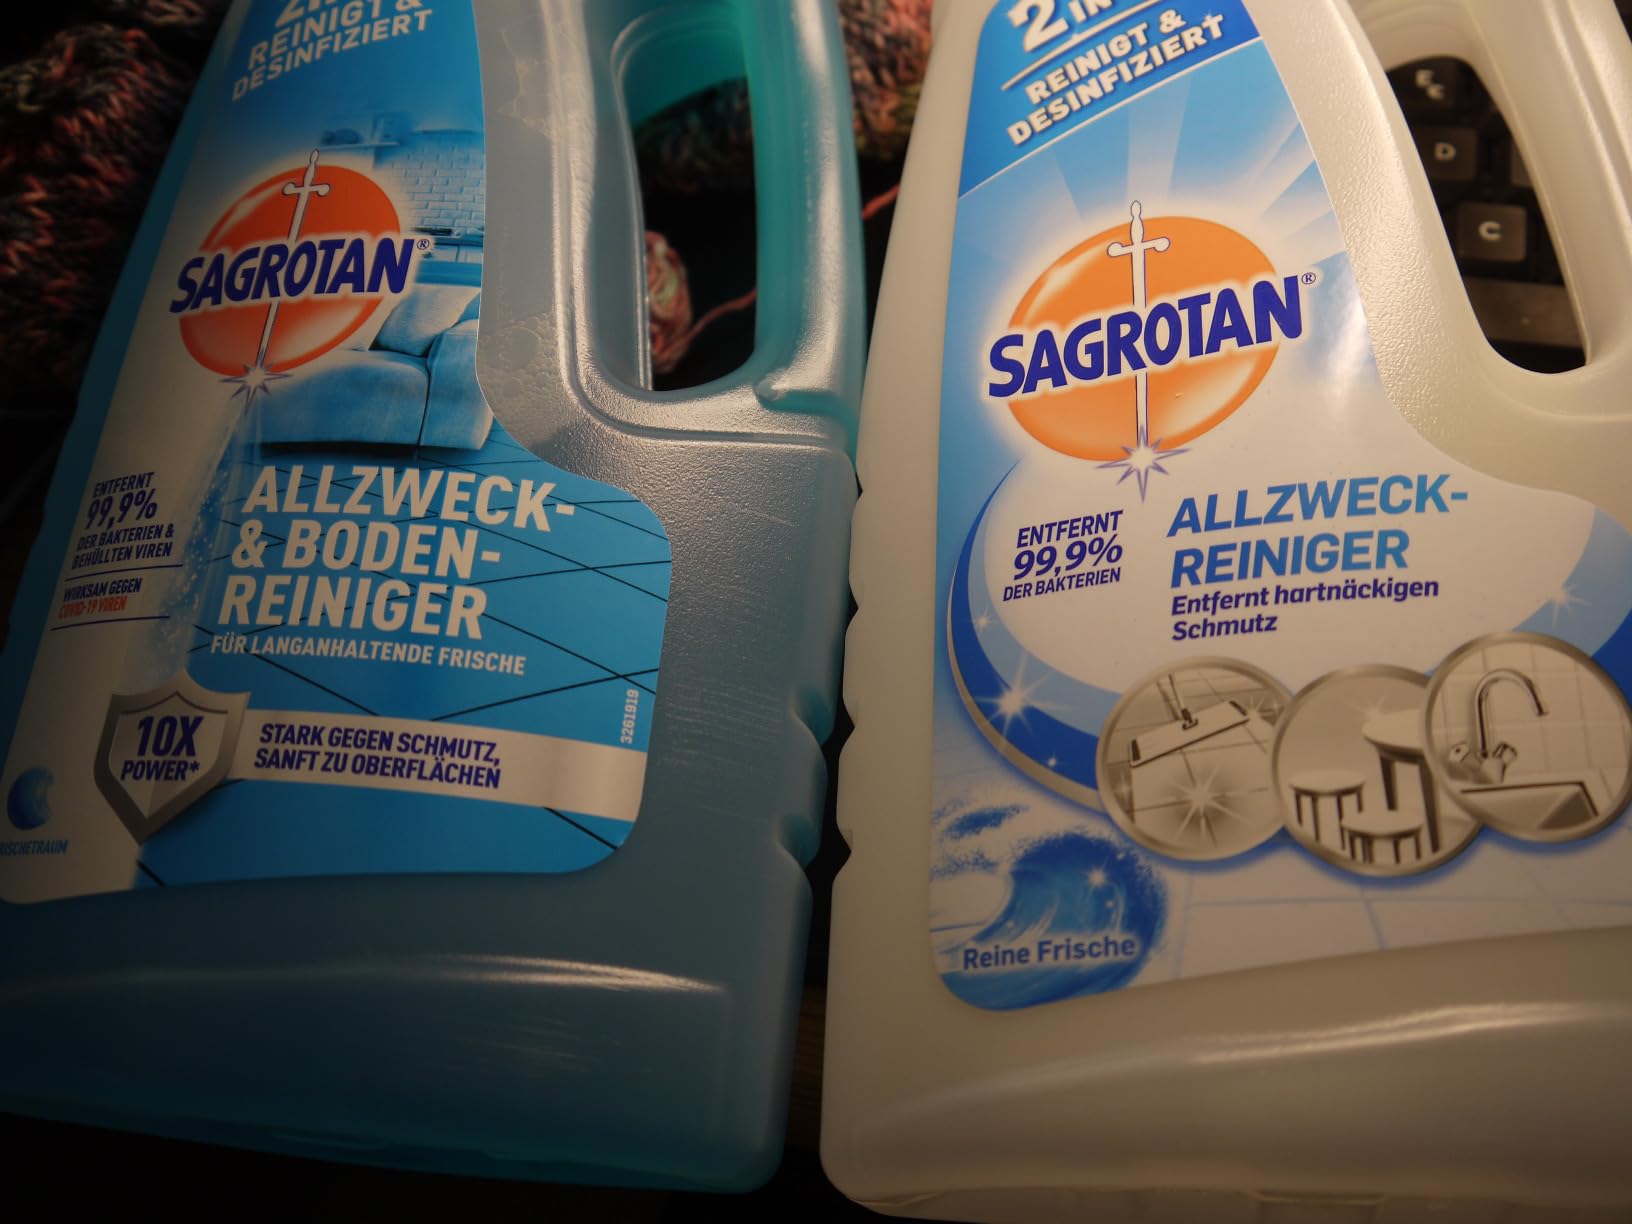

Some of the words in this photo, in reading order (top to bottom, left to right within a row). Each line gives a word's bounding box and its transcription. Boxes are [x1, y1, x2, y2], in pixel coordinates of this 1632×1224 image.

[248, 0, 384, 68] REINIGT
[231, 9, 433, 102] DESINFIZIERT
[1025, 21, 1148, 104] REINIGT
[1158, 9, 1187, 34] &
[1007, 14, 1224, 146] DESINFIZIERT
[1434, 142, 1456, 161] D
[1478, 221, 1502, 241] C
[93, 472, 154, 498] ENTFERNT
[241, 464, 576, 532] ALLZWECK-
[85, 488, 157, 530] 99,9%
[1167, 474, 1469, 538] ALLZWECK-
[77, 533, 98, 550] DER
[99, 524, 163, 546] BAKTERIEN
[165, 523, 174, 538] &
[231, 519, 268, 568] &
[281, 518, 501, 579] BODEN-
[1017, 510, 1124, 548] ENTFERNT
[71, 545, 133, 570] BEHÜLLTEN
[135, 541, 173, 559] VIREN
[1013, 533, 1123, 580] 99,9%
[1170, 529, 1410, 588] REINIGER
[63, 583, 107, 602] WIRKSAM
[108, 578, 142, 595] GEGEN
[98, 596, 128, 612] VIREN
[1003, 582, 1034, 602] DER
[1035, 567, 1122, 595] BAKTERIEN
[1171, 585, 1270, 615] Entfernt
[1274, 576, 1439, 602] hartnäckigen
[218, 574, 488, 640] REINIGER
[1172, 613, 1279, 641] Schmutz
[210, 631, 247, 655] FÜR
[251, 635, 433, 666] LANGANHALTENDE
[438, 646, 527, 676] FRISCHE
[138, 716, 204, 757] 10X
[260, 723, 325, 746] STARK
[328, 726, 393, 752] GEGEN
[397, 733, 500, 766] SCHMUTZ,
[254, 747, 320, 770] SANFT
[321, 751, 347, 773] ZU
[352, 756, 501, 788] OBERFLÄCHEN
[963, 944, 1030, 970] Reine
[1037, 935, 1136, 963] Frische
